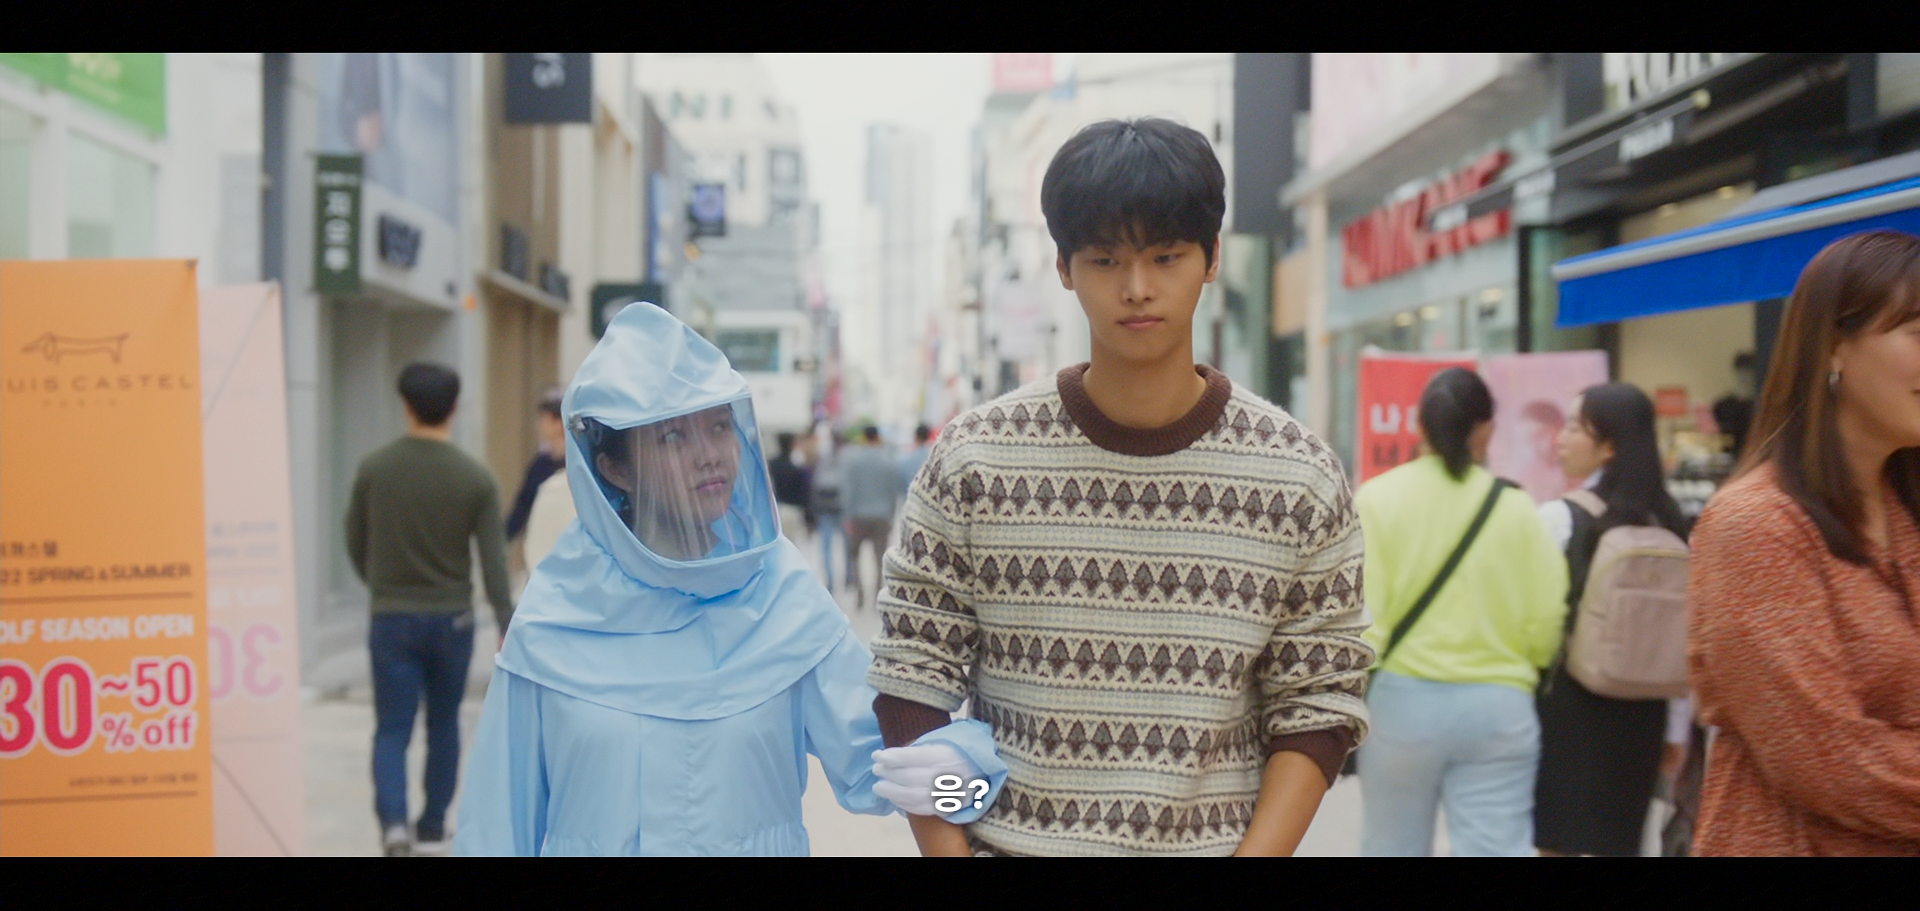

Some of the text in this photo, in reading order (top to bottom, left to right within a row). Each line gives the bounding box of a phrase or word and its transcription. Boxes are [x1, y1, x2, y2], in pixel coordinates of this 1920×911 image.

[71, 373, 194, 391] CASTEL
[28, 565, 94, 585] SPRING
[110, 563, 191, 581] SUMMER
[41, 616, 129, 643] SEASON
[134, 613, 195, 639] OPEN
